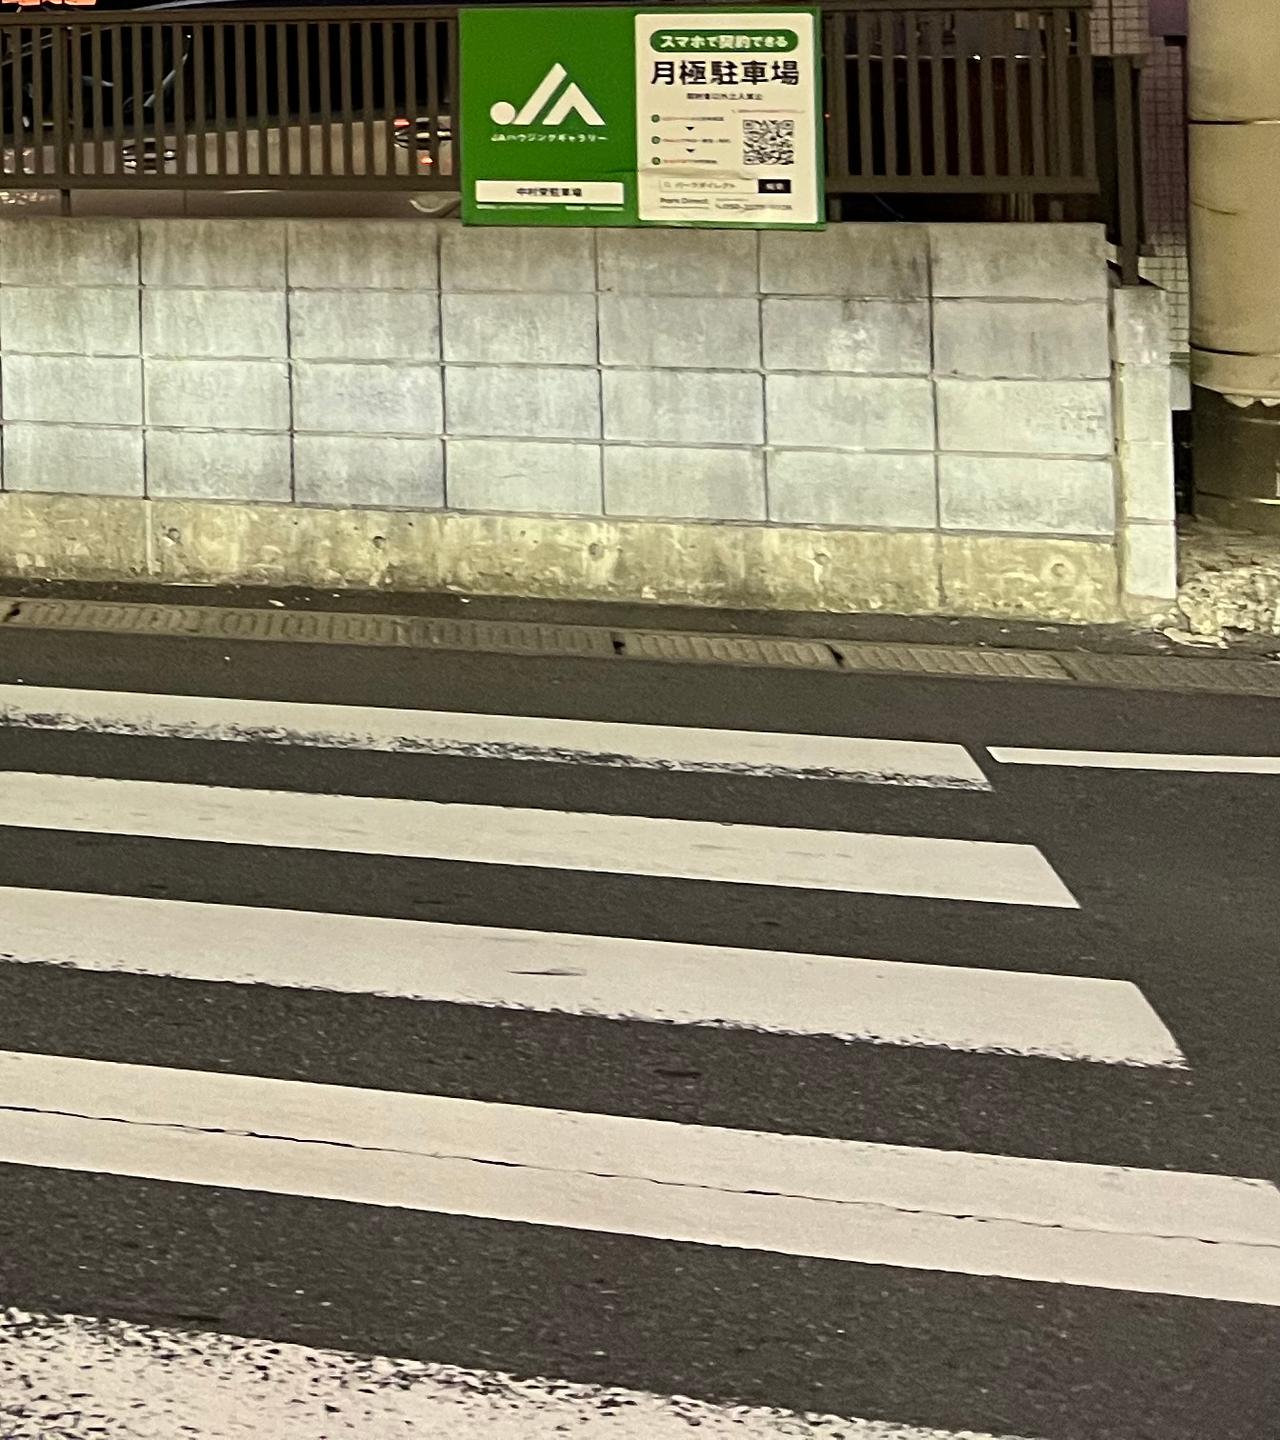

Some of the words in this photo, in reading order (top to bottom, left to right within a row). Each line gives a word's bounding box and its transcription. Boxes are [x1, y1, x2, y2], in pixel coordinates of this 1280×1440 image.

[660, 35, 789, 50] スマホで契約できる
[651, 59, 800, 86] 月極駐車場
[490, 133, 608, 143] JAハウジングギャラリー
